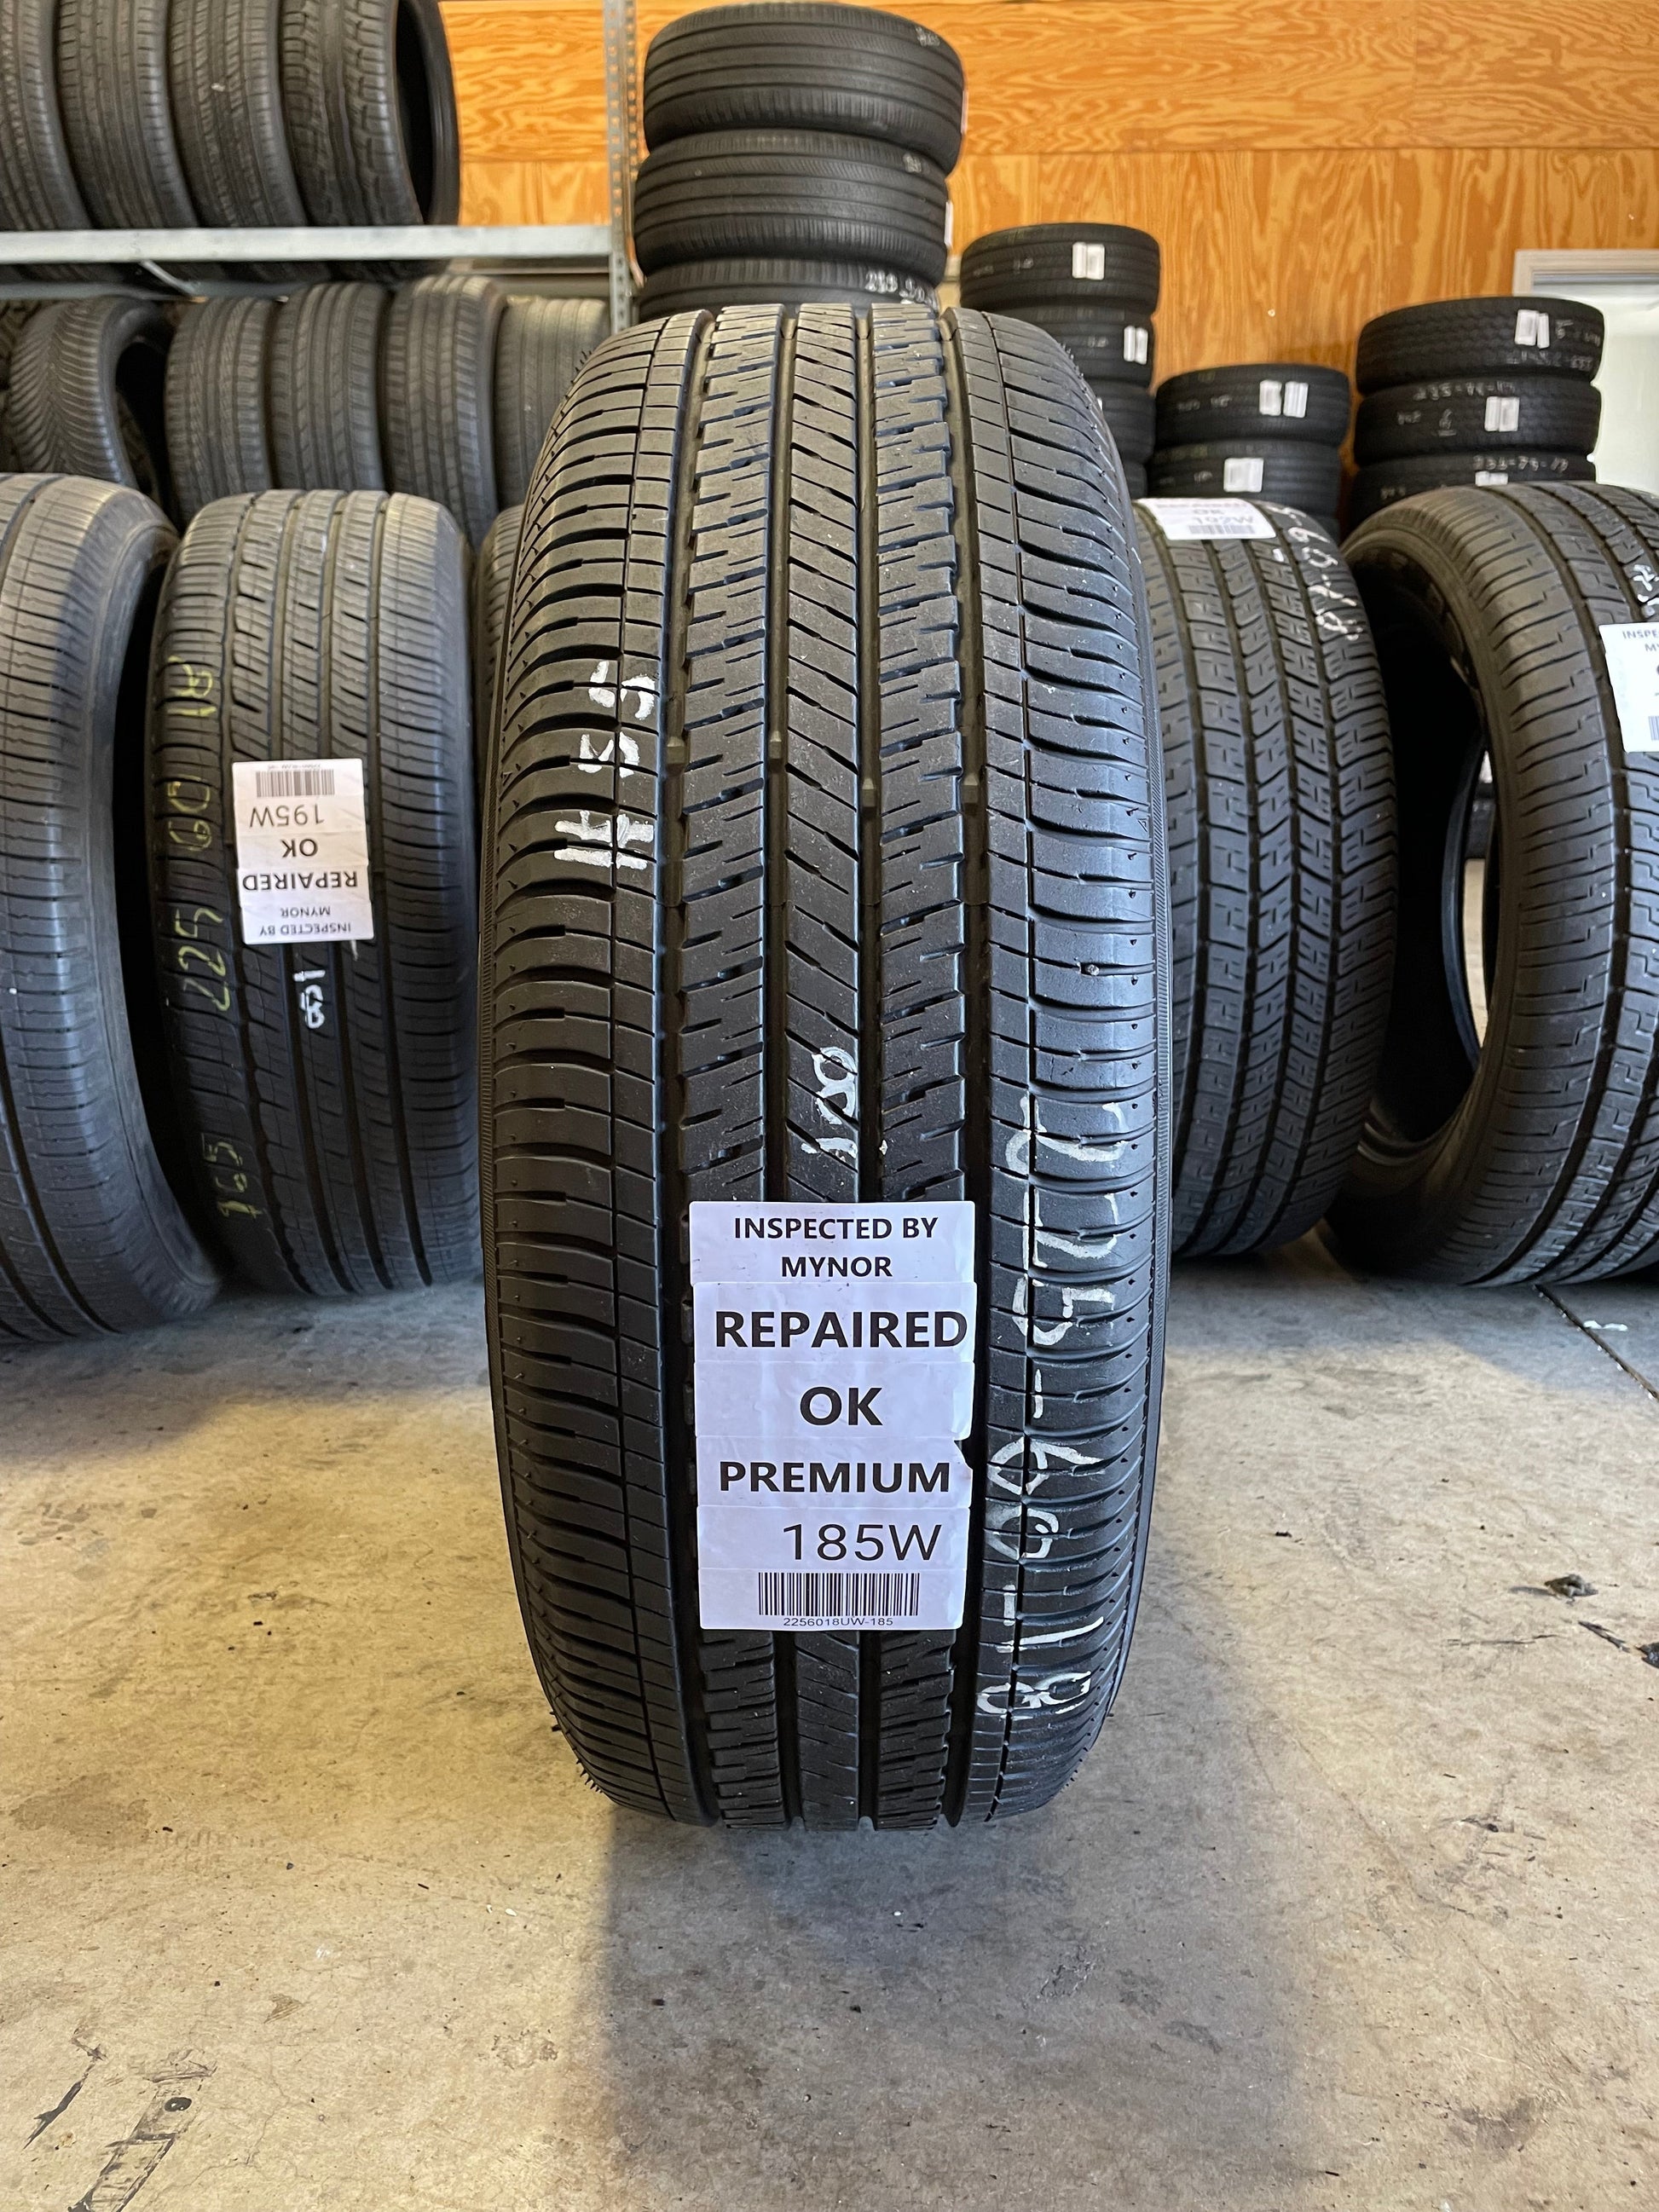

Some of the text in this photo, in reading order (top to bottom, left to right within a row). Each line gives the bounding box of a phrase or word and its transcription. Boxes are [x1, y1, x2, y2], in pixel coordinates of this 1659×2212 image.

[249, 803, 325, 828] 195W
[280, 838, 319, 858] OK
[242, 870, 358, 892] REPAIRED
[280, 905, 331, 918] MYNOR
[259, 922, 351, 936] INSPECTED BY
[734, 1216, 938, 1239] INSPECTED BY
[781, 1256, 893, 1277] MYNOR
[715, 1310, 968, 1349] REPAIRED
[799, 1386, 883, 1426] OK
[720, 1461, 951, 1493] PREMIUM
[782, 1523, 942, 1561] 185W
[783, 1617, 893, 1626] 2256018UW-185
